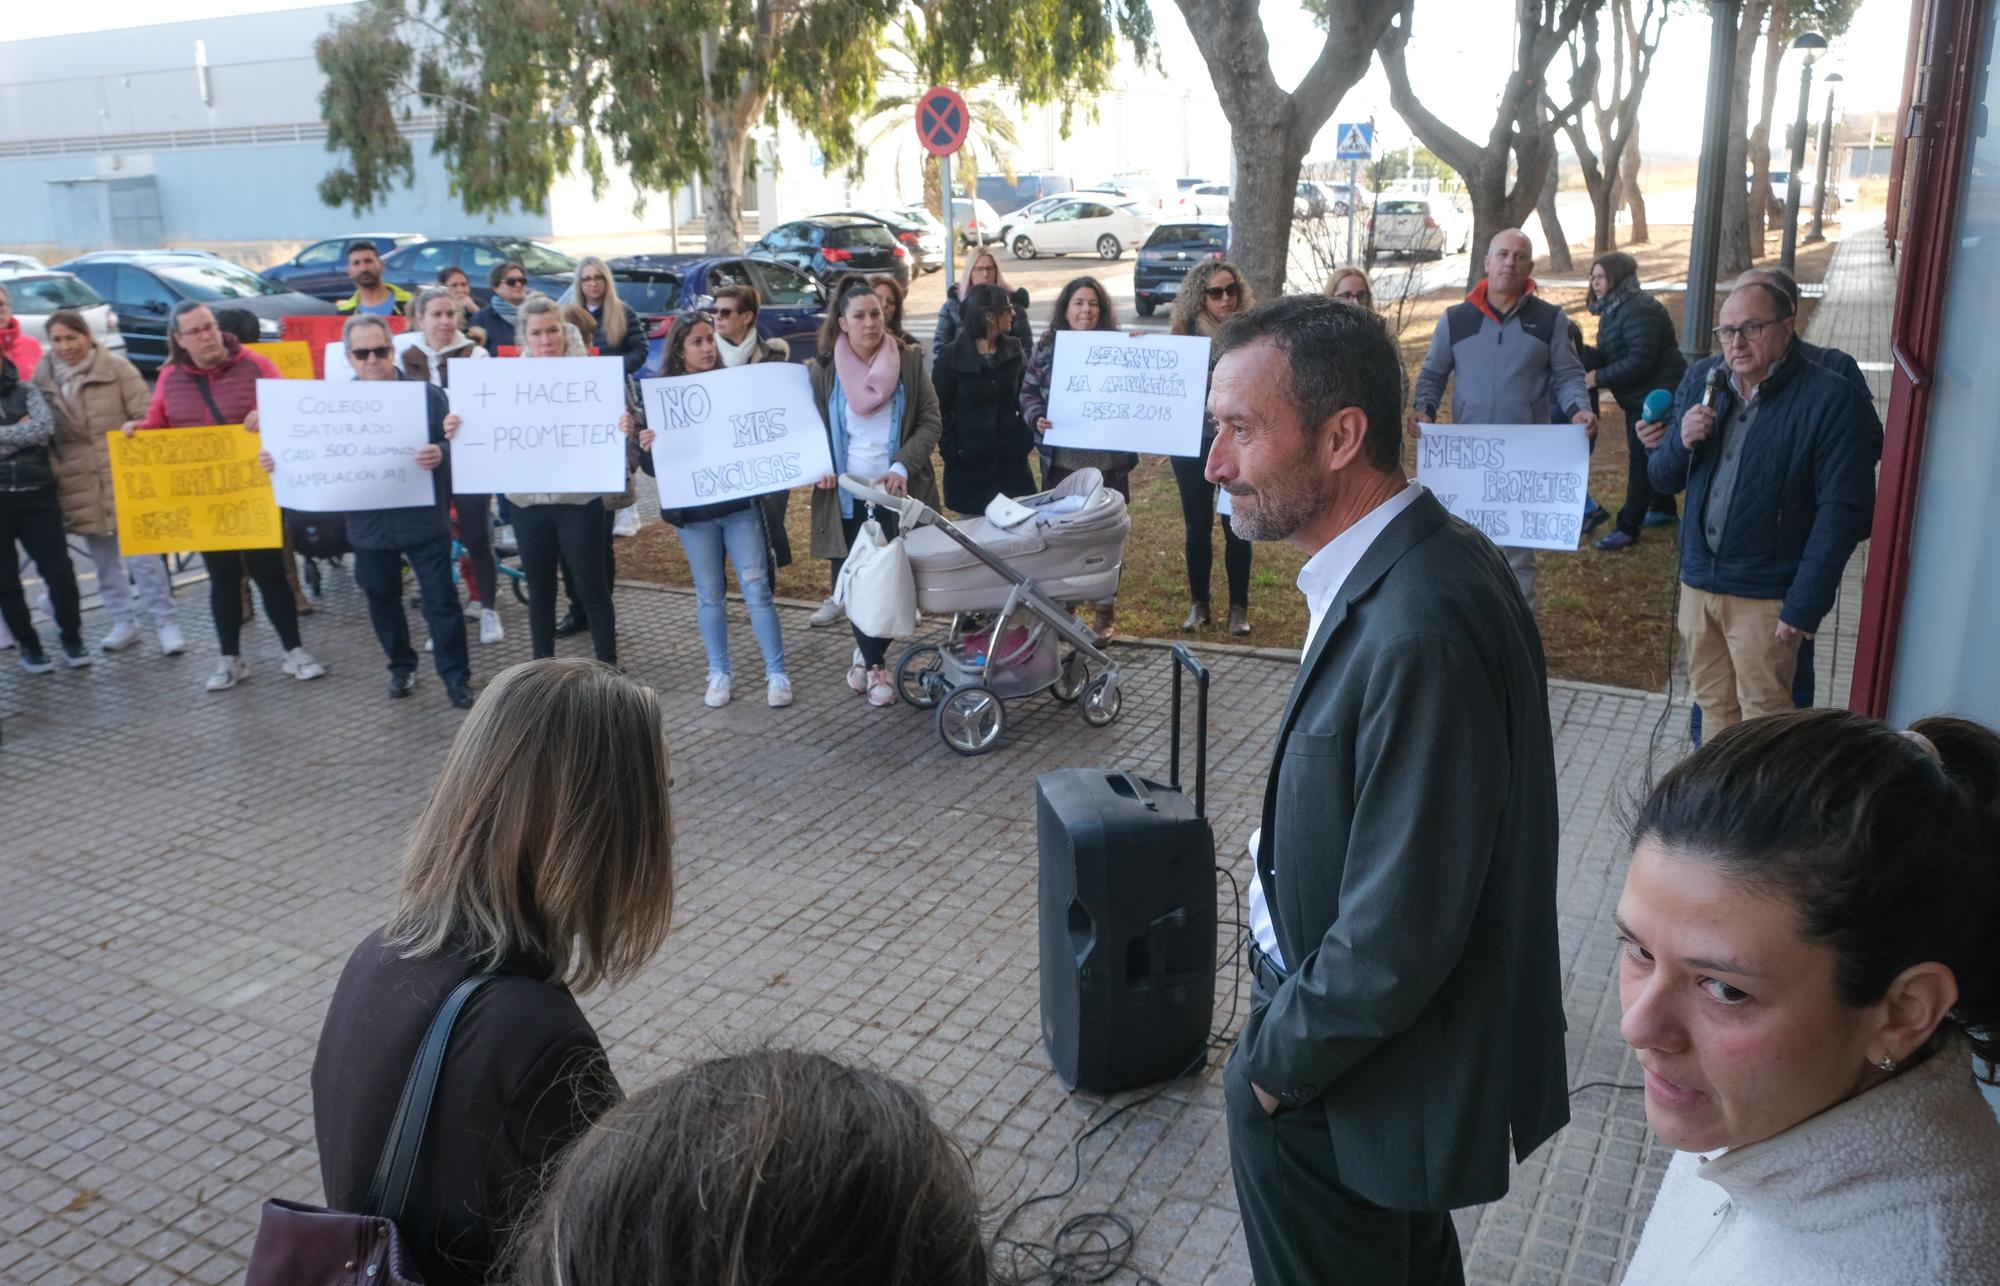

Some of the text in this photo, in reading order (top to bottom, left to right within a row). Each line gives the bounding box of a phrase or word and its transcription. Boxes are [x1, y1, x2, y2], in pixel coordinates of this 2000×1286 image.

[515, 380, 602, 404] HACER
[1066, 372, 1187, 398] LA AMPLIACIÓN
[297, 396, 383, 415] COLEGIO
[655, 384, 712, 431] NO
[1082, 401, 1173, 421] DESDE 2018
[288, 423, 394, 439] SATURADO
[493, 423, 618, 453] PROMETER
[728, 408, 787, 448] MAS
[281, 448, 316, 463] CASI
[323, 443, 358, 458] 500
[1423, 434, 1505, 470] MENOS
[123, 472, 158, 499] LA
[691, 452, 802, 498] EXCUSAS
[1483, 471, 1582, 504] PROMETER
[208, 497, 270, 536] 2018
[1465, 510, 1510, 537] MAS
